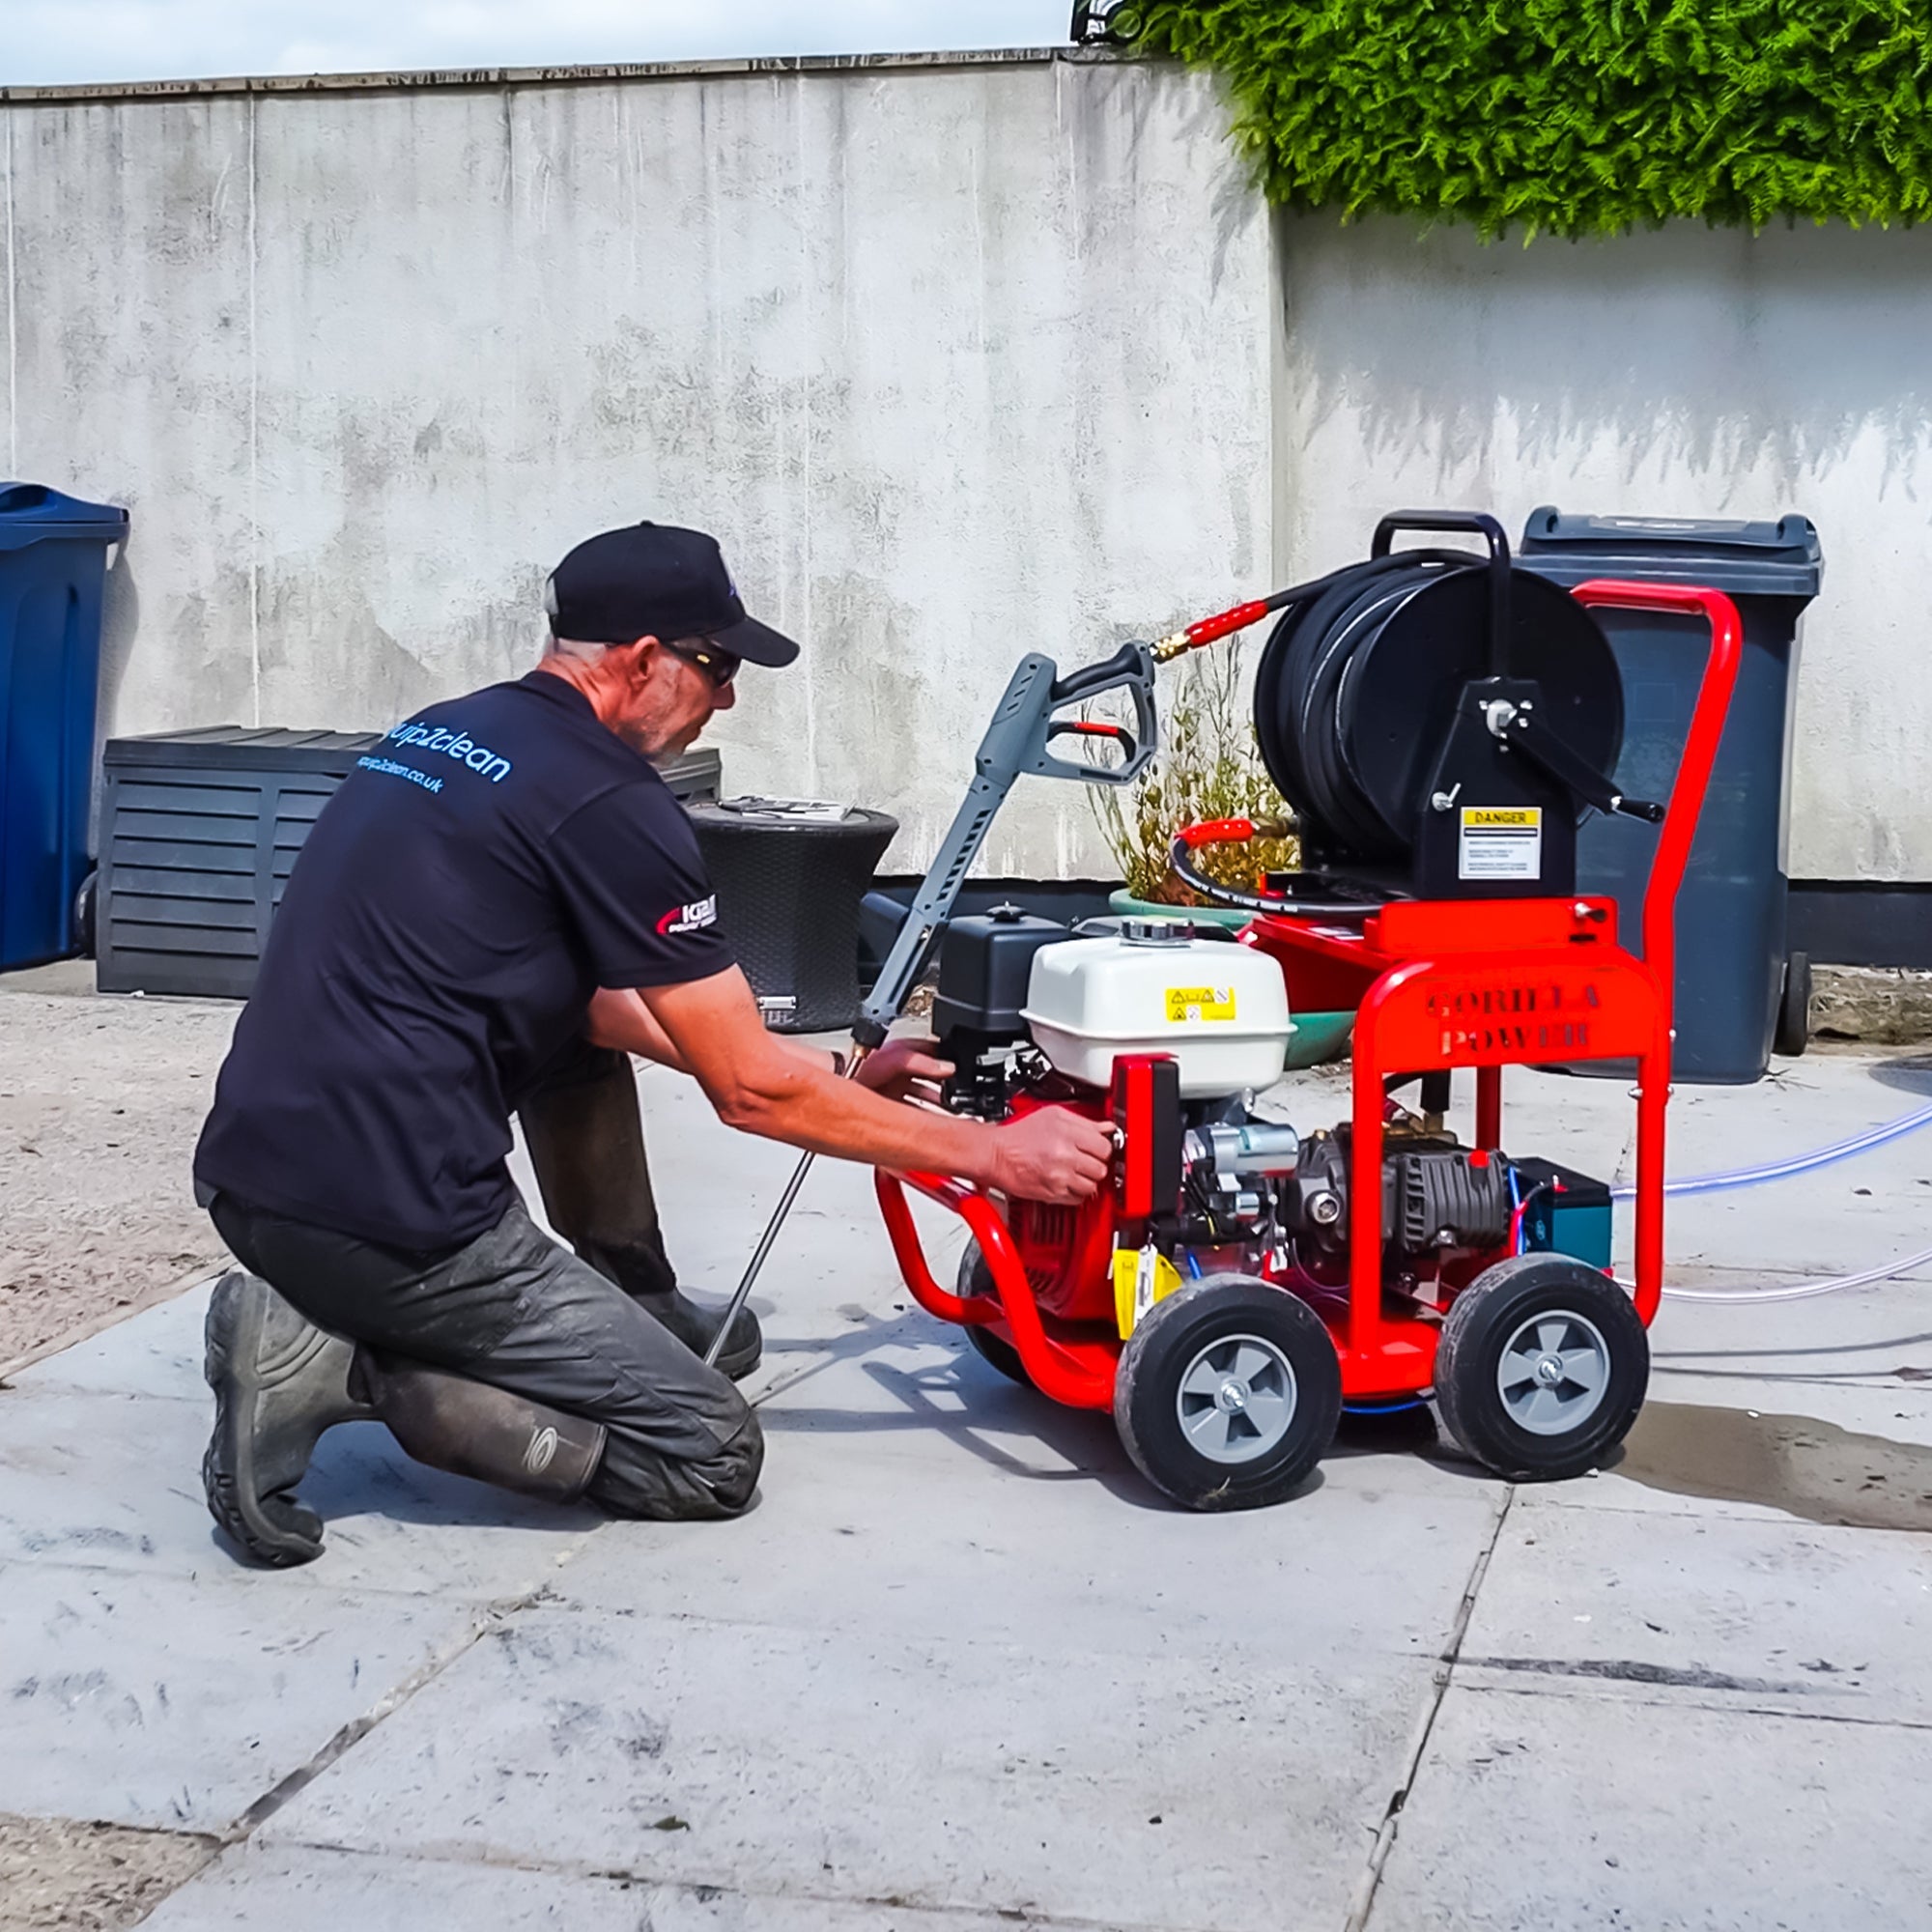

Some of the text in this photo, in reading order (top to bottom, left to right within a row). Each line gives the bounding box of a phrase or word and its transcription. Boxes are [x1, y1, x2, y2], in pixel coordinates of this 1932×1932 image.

[1474, 811, 1526, 824] DANGER
[1428, 985, 1599, 1016] GORILLA
[1442, 1023, 1587, 1055] POWER
